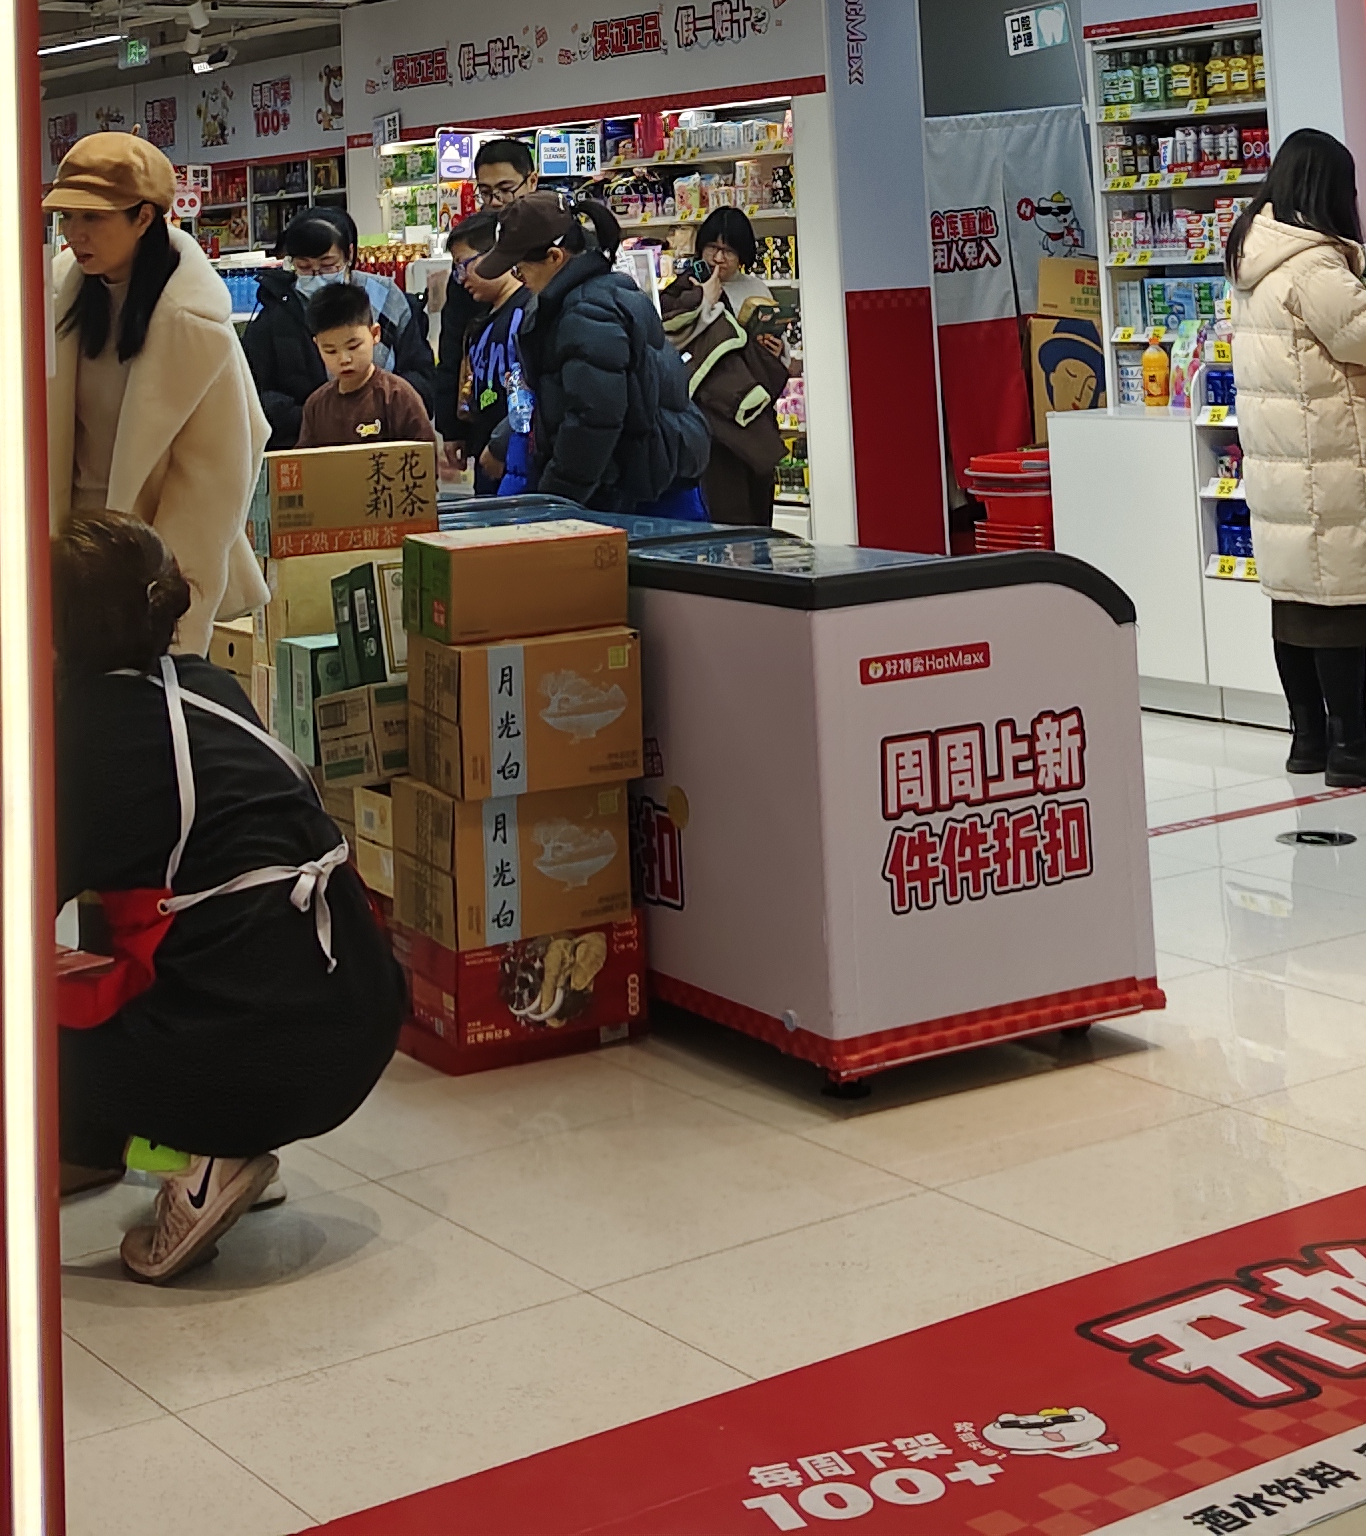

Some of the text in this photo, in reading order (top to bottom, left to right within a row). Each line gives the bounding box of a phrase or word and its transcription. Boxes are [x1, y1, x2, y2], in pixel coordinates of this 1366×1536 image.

[392, 47, 450, 91] 保证正品
[458, 35, 520, 82] 假一赔十
[593, 11, 661, 61] 保证正品
[930, 208, 997, 240] 仓库重地
[276, 526, 398, 556] 果子熟了无糖茶
[496, 664, 521, 782] 月光白
[885, 710, 1084, 817] 周周上新
[491, 812, 516, 929] 月光白
[885, 804, 1090, 910] 件件折扣
[742, 1459, 1006, 1532] 100+
[748, 1432, 955, 1491] 每周下架
[1183, 1460, 1362, 1536] 酒水饮料
